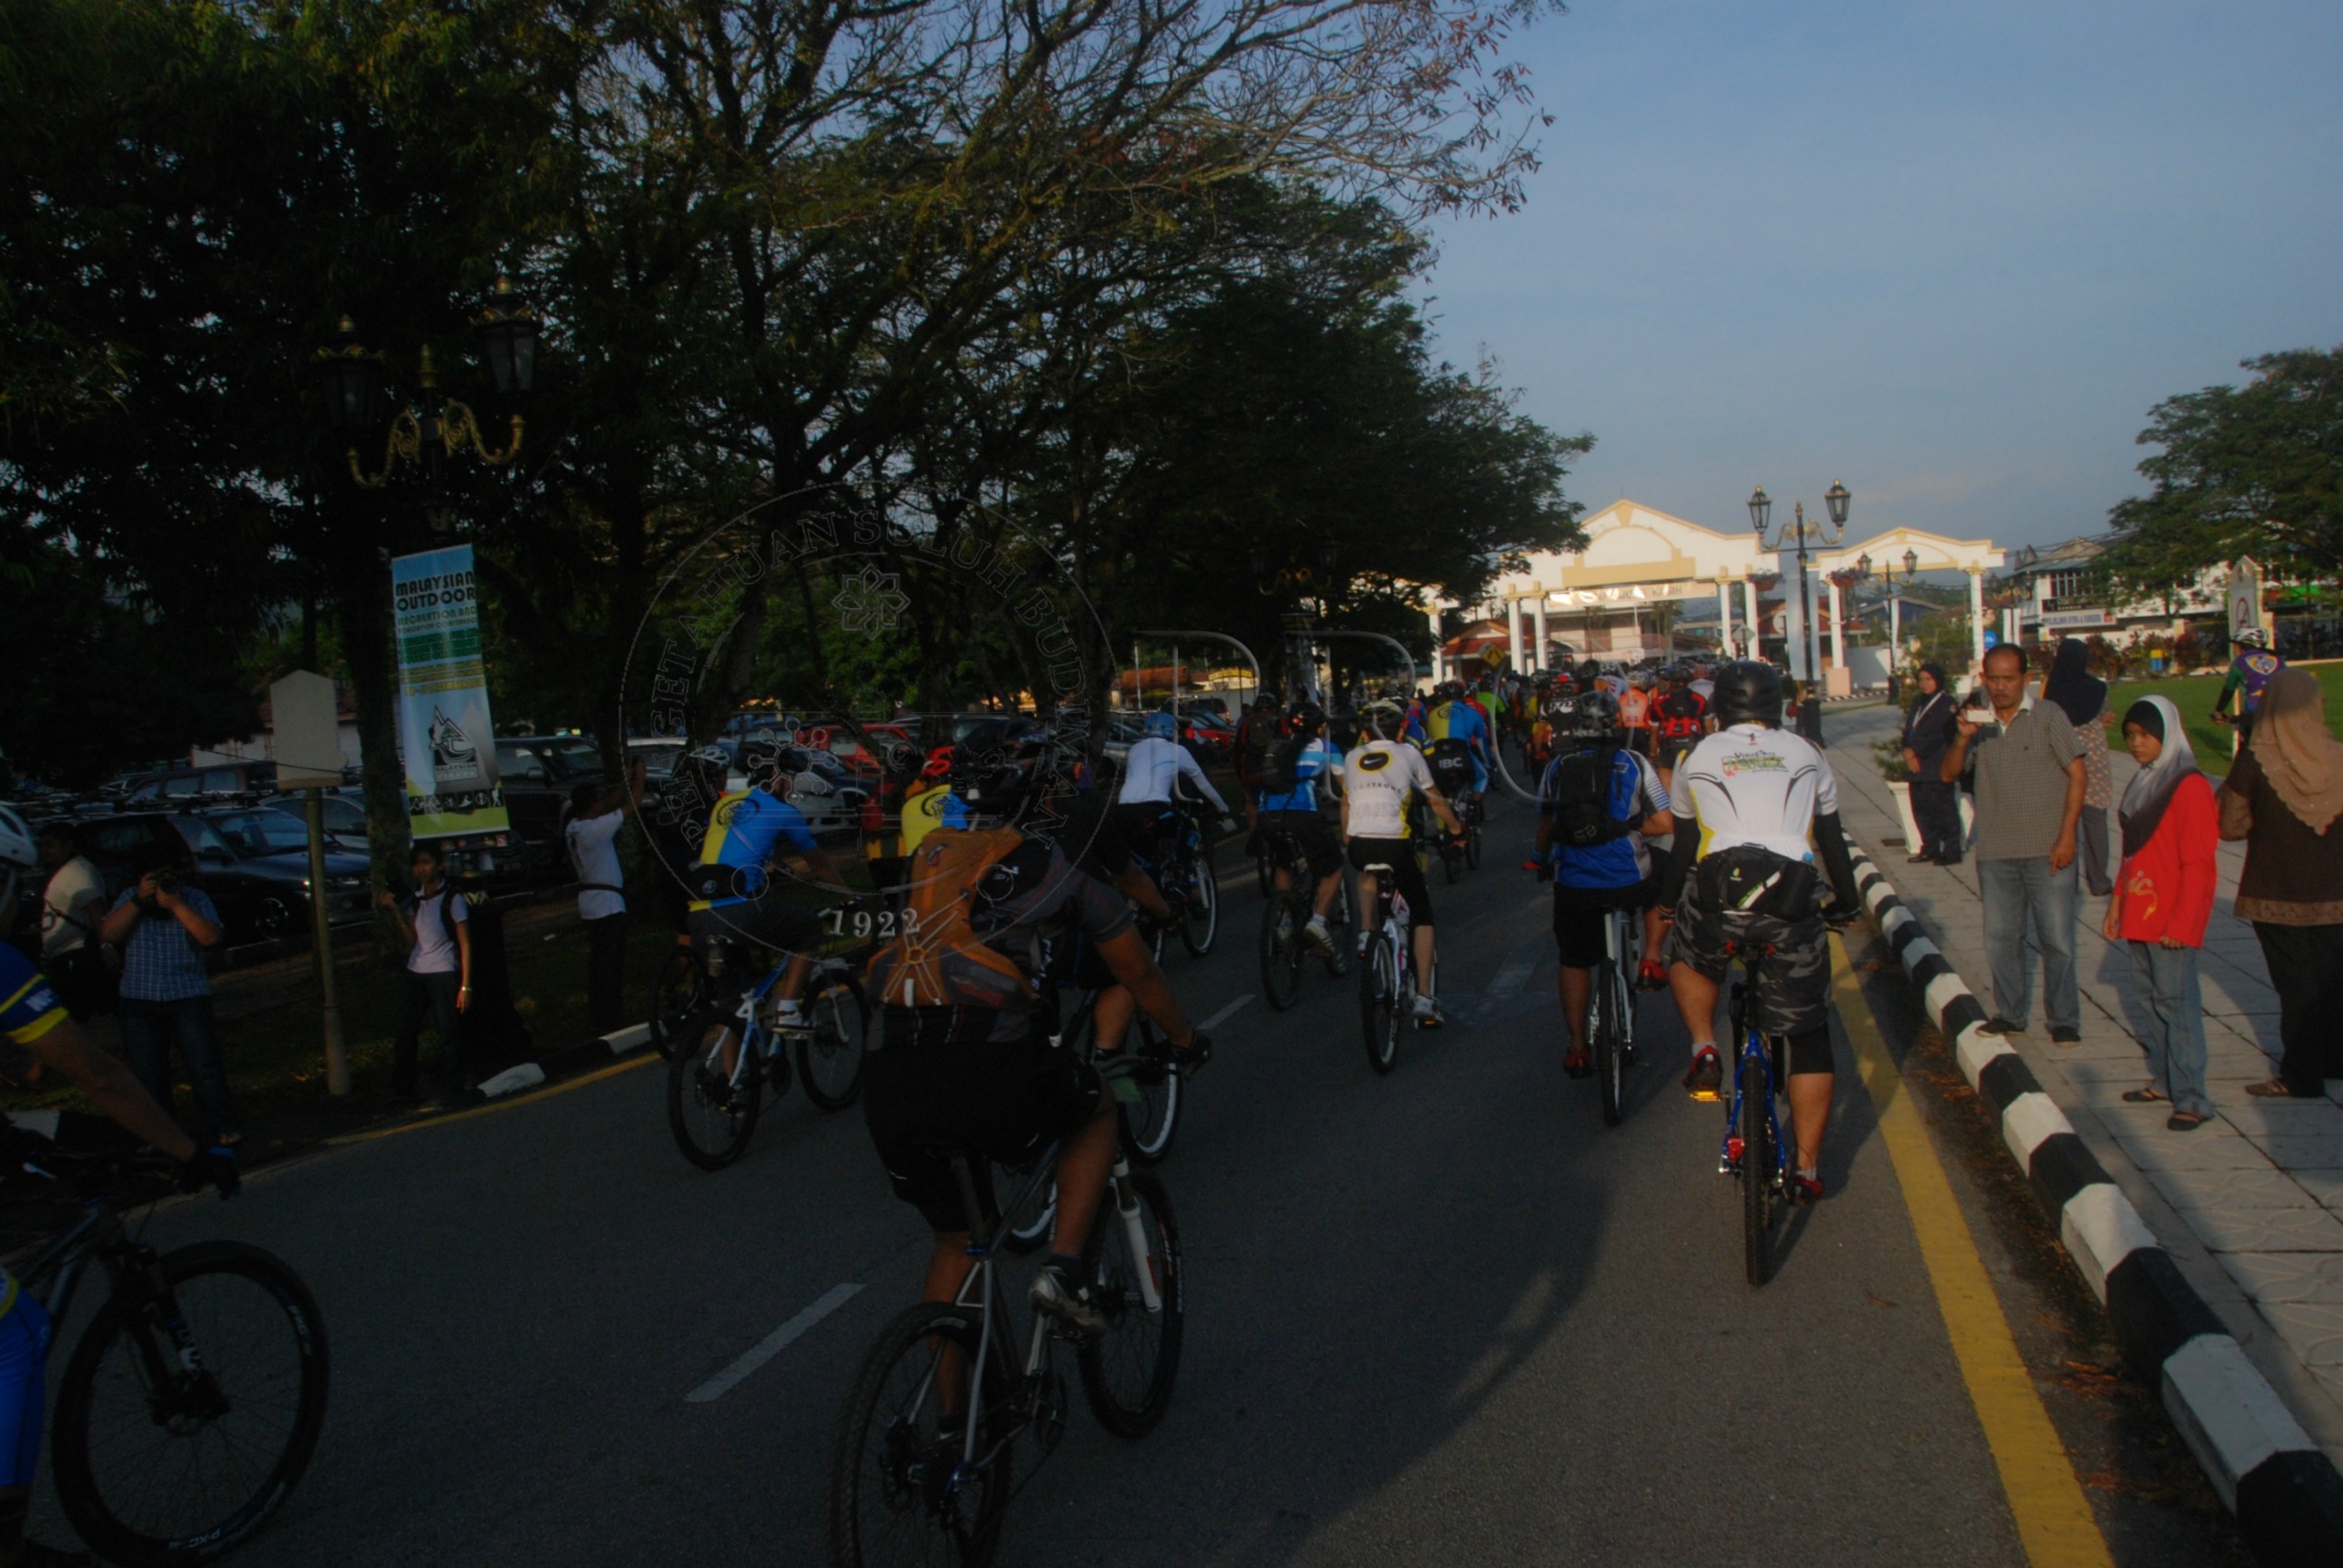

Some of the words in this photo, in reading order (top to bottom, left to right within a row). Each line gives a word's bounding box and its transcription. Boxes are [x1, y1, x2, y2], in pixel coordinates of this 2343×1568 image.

[395, 571, 475, 596] MALAYSIAN
[396, 587, 476, 612] OUTDOOR
[398, 608, 457, 626] RECREATION
[457, 606, 477, 616] AND
[1438, 756, 1463, 769] IBC
